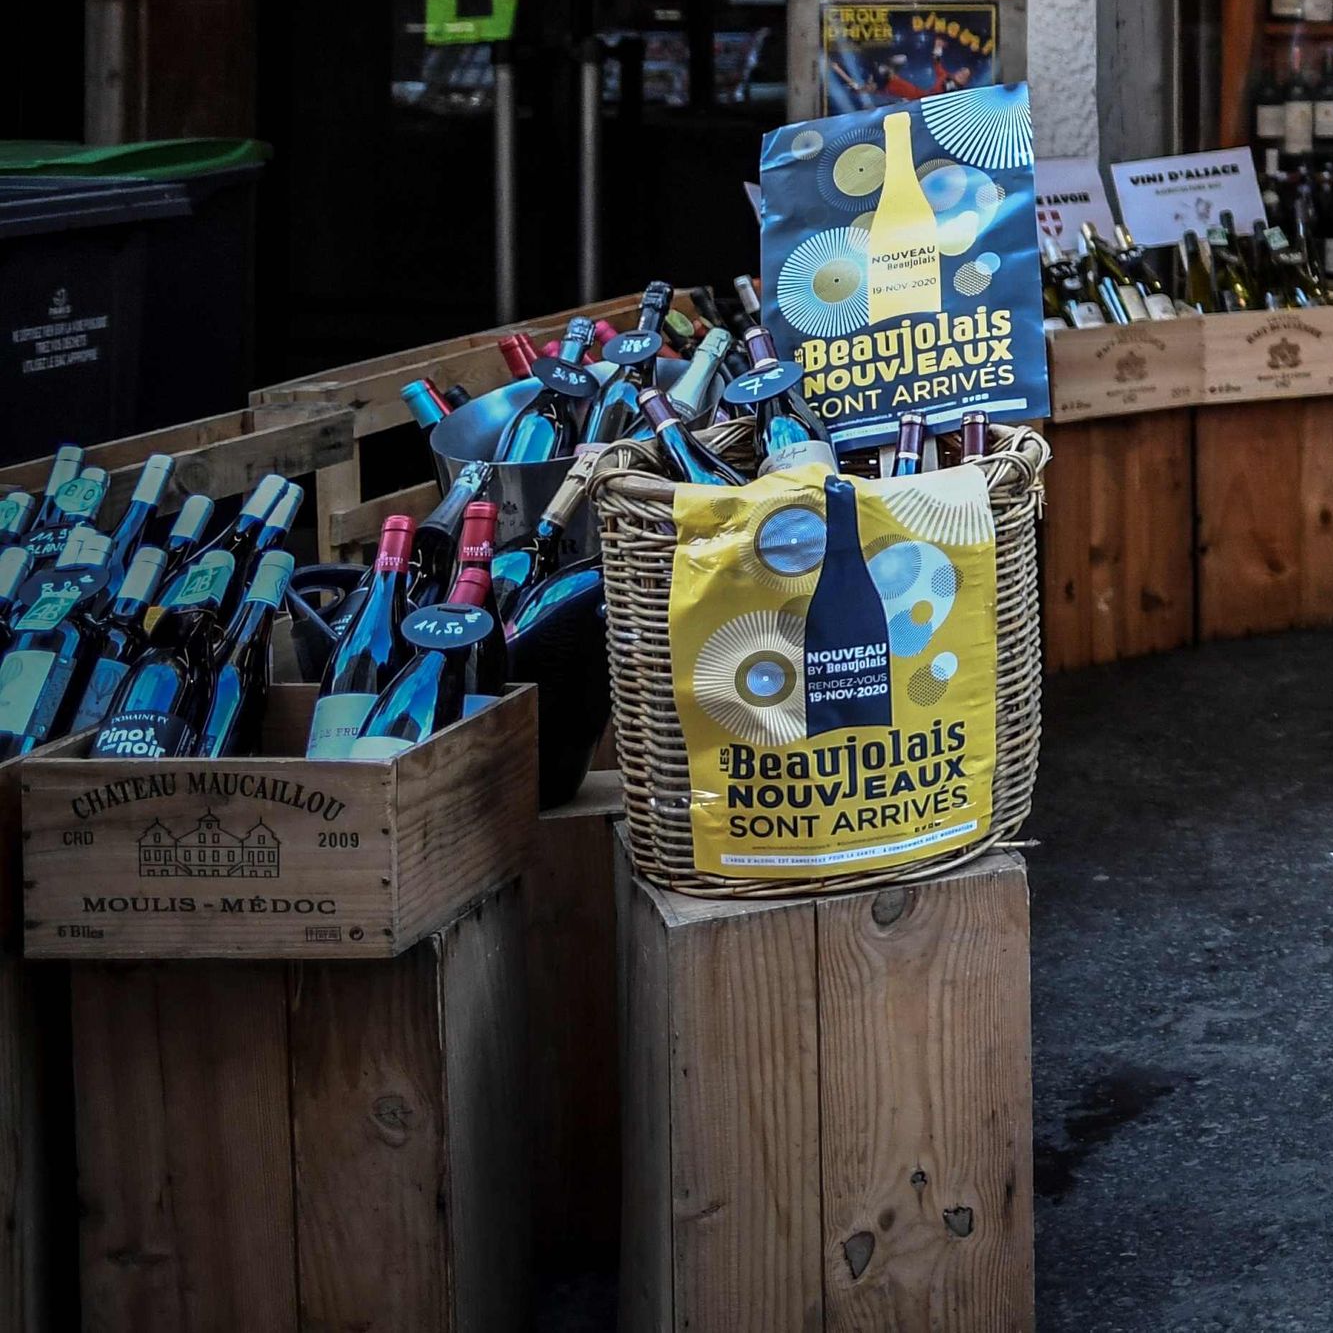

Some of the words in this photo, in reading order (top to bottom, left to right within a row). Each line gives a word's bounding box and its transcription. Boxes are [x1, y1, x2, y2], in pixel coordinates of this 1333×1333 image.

[871, 244, 936, 265] NOUVEAU
[886, 254, 937, 272] Beaujolais
[803, 305, 1013, 375] Beaujolais
[794, 347, 806, 364] ES
[807, 388, 883, 420] SONT
[890, 362, 1016, 408] ARRIVÉS
[64, 483, 96, 502] BIO
[807, 642, 888, 665] NOUVEAU
[807, 665, 825, 677] BY
[825, 655, 888, 677] Beaujolais
[807, 672, 888, 692] RENDEZ-VOUS
[96, 726, 156, 749] Pinot
[115, 740, 167, 759] noir
[719, 747, 730, 774] LES
[727, 718, 966, 799] Beaujolais
[70, 772, 178, 820] CHATEAU
[186, 771, 347, 822] MAUCAILLOU
[728, 814, 821, 840] SONT
[830, 784, 969, 837] ARRIVÉS
[62, 830, 95, 847] CRD
[317, 830, 361, 849] 2009
[82, 895, 197, 914] MOULIS
[220, 892, 337, 915] MÉDOC
